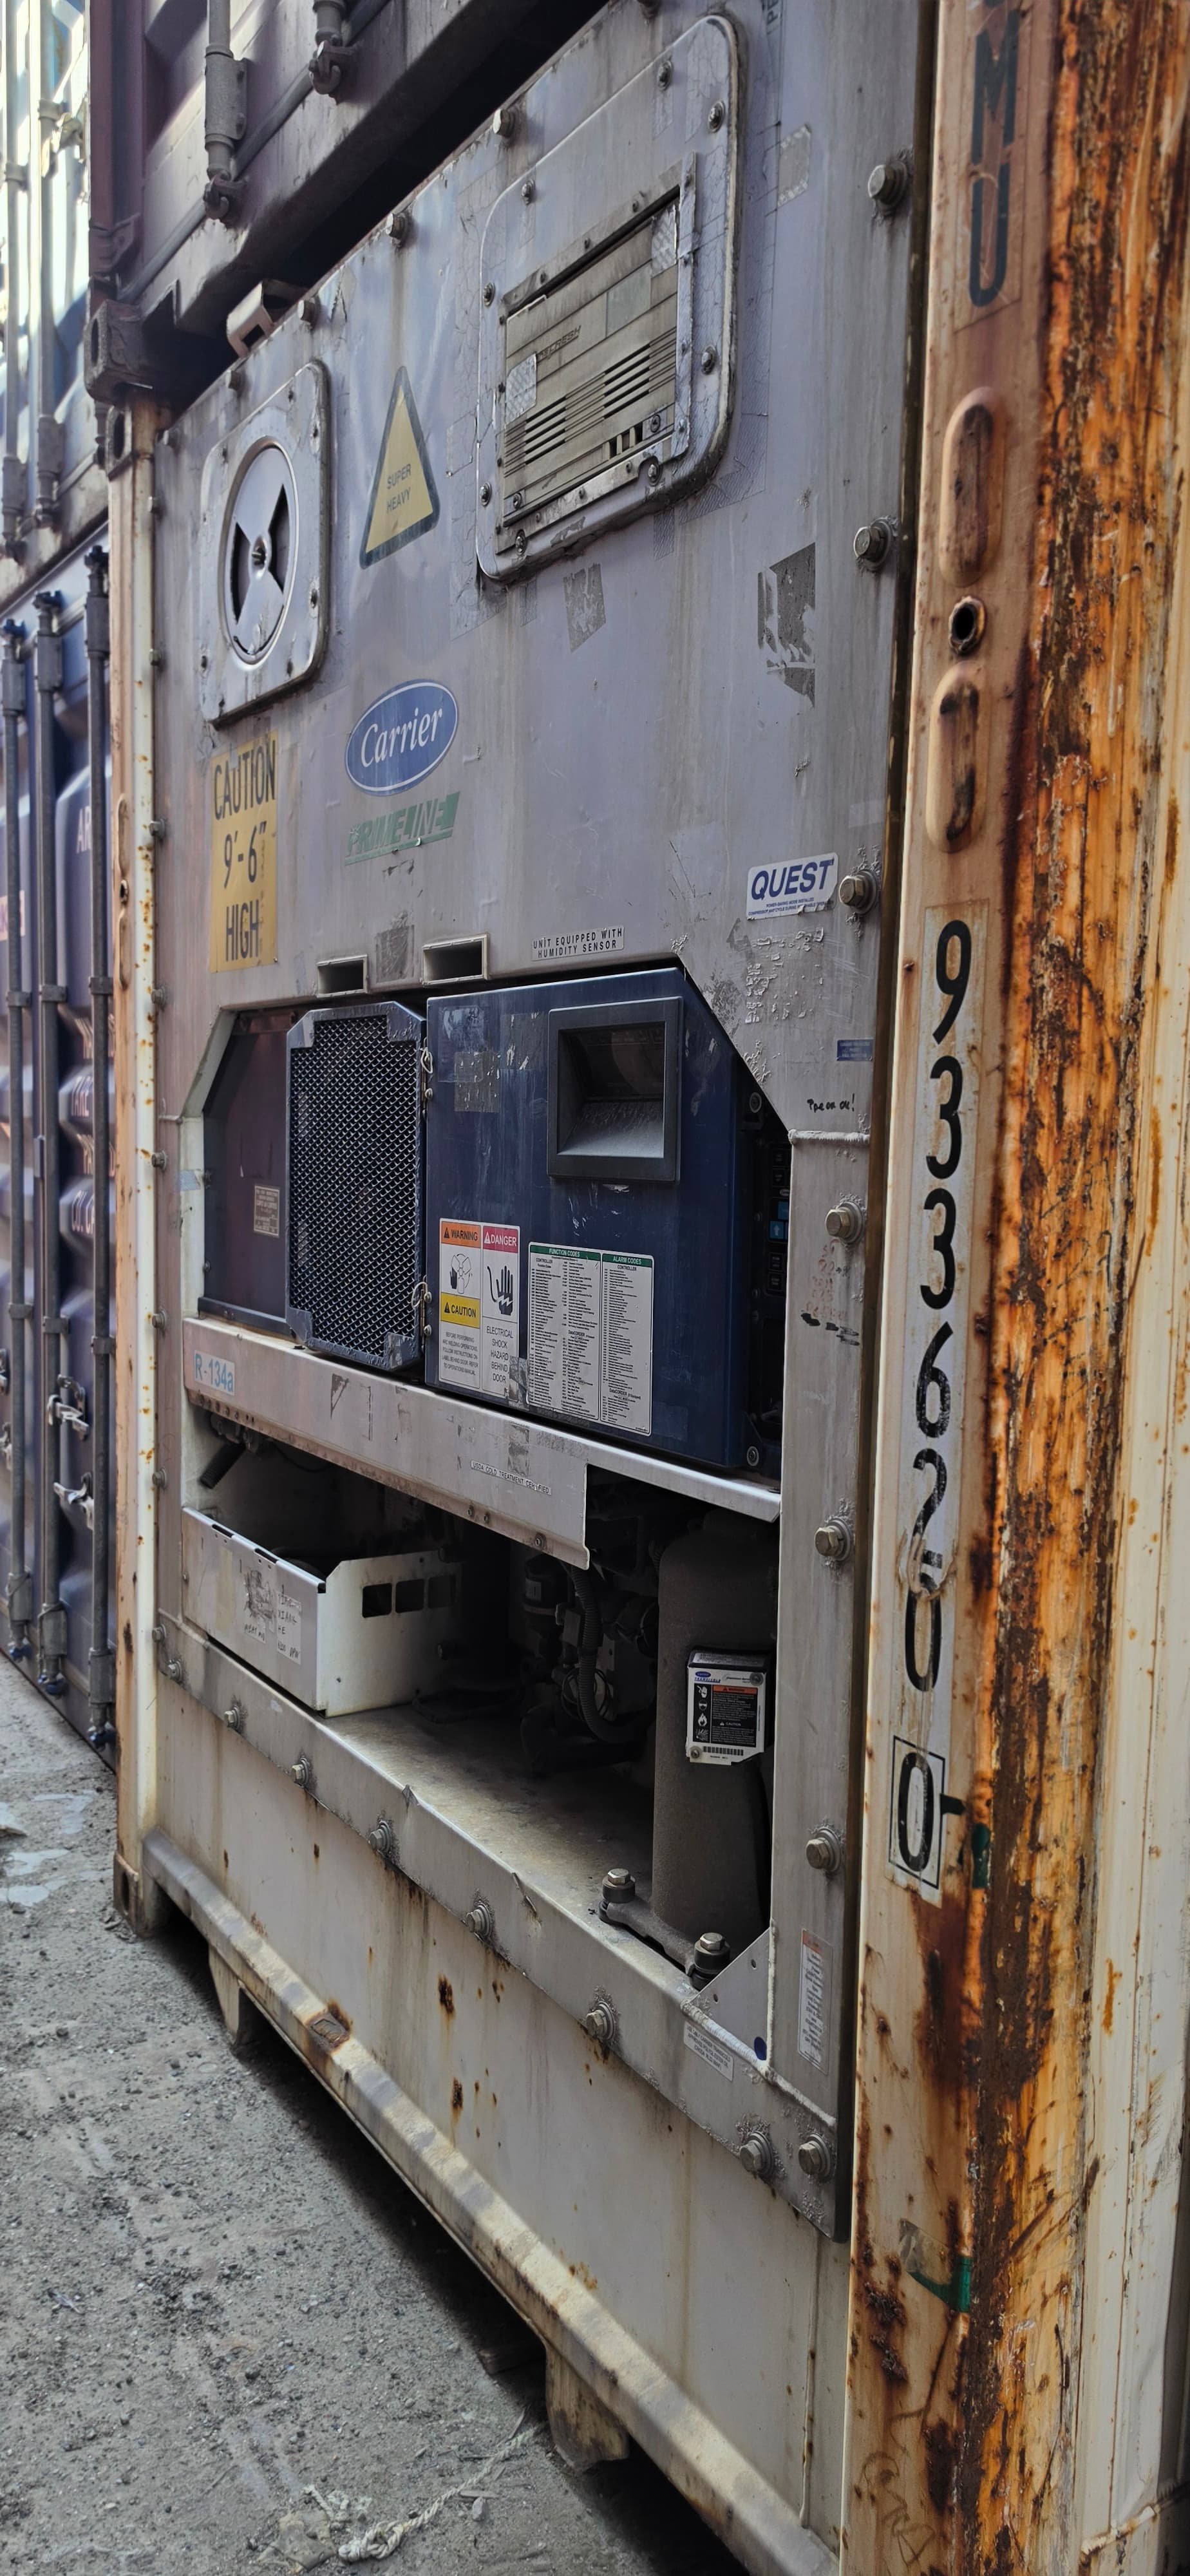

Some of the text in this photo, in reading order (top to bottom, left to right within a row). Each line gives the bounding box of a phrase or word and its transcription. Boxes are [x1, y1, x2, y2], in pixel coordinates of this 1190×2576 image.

[968, 0, 1021, 307] MU
[387, 463, 411, 489] SUPER
[386, 487, 411, 514] HEAVY
[361, 707, 443, 768] Carrier
[214, 739, 276, 820] CAUTION
[751, 857, 835, 900] QUEST
[225, 899, 260, 961] HIGH
[533, 927, 623, 949] UNIT EQUIPPED WITH
[538, 939, 616, 958] HUMIDITY SENSOR
[451, 1228, 517, 1247] WARNING DANGER
[451, 1303, 477, 1318] CAUTION
[486, 1325, 514, 1338] ELECTRICAL
[491, 1338, 508, 1349] SHOCK
[491, 1349, 509, 1360] HAZARD
[195, 1353, 233, 1392] R-134a
[491, 1361, 508, 1372] BEHIND
[493, 1372, 506, 1383] DOOR
[499, 1470, 524, 1484] TREATMENT
[897, 1750, 935, 1873] 0
